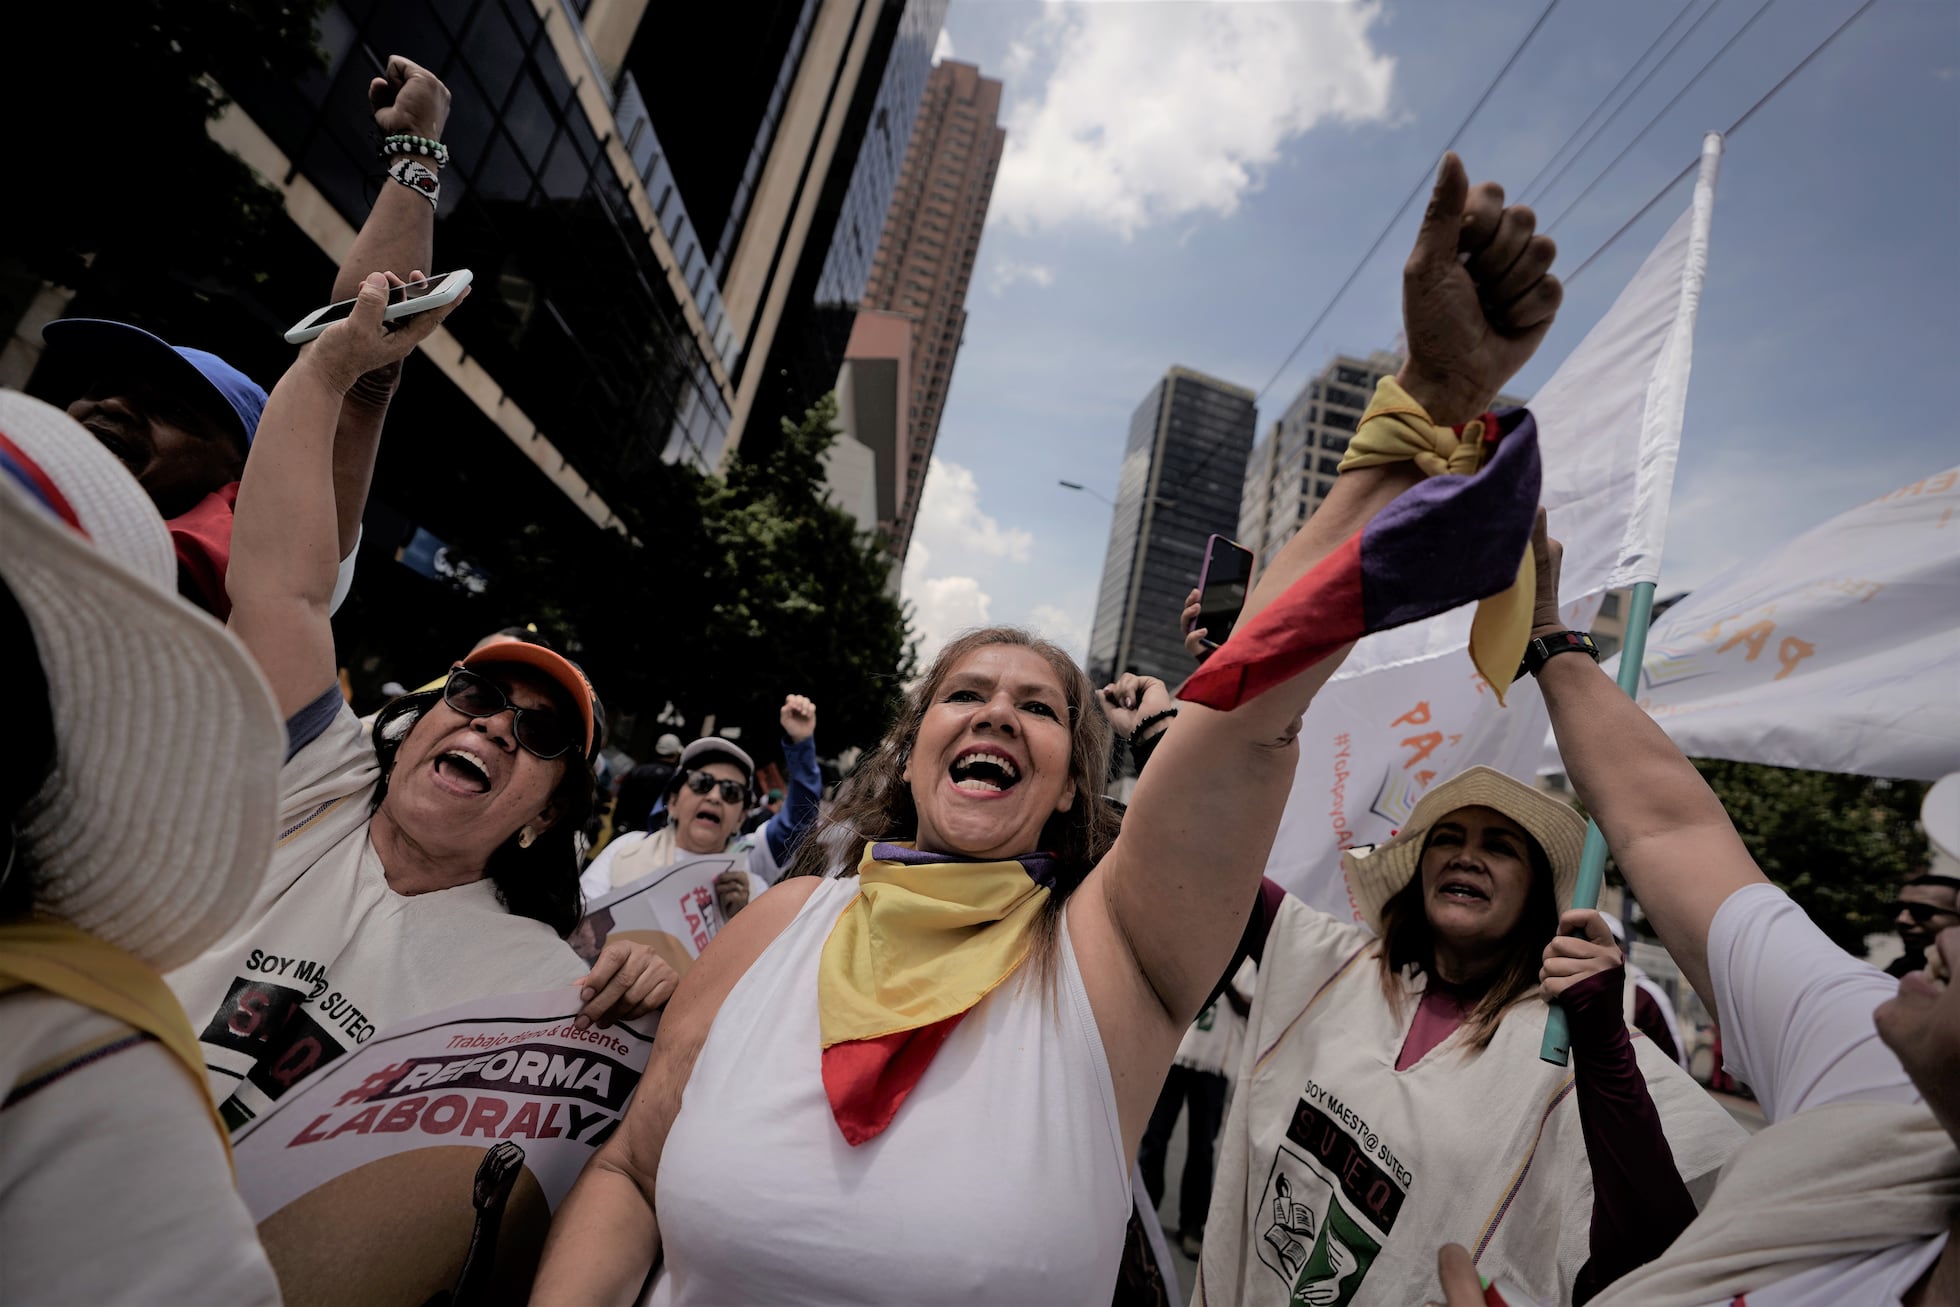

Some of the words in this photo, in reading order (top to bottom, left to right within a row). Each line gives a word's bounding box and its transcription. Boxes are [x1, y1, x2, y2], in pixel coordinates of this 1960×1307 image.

[246, 949, 295, 976] SOY
[319, 992, 376, 1044] SUTEQ
[446, 1034, 508, 1050] Trabajo
[560, 1023, 630, 1057] decente
[333, 1050, 613, 1107] #REFORMA
[1305, 1080, 1327, 1103] SOY
[1327, 1095, 1379, 1152] MAESTR@
[1378, 1145, 1412, 1189] SUTEQ
